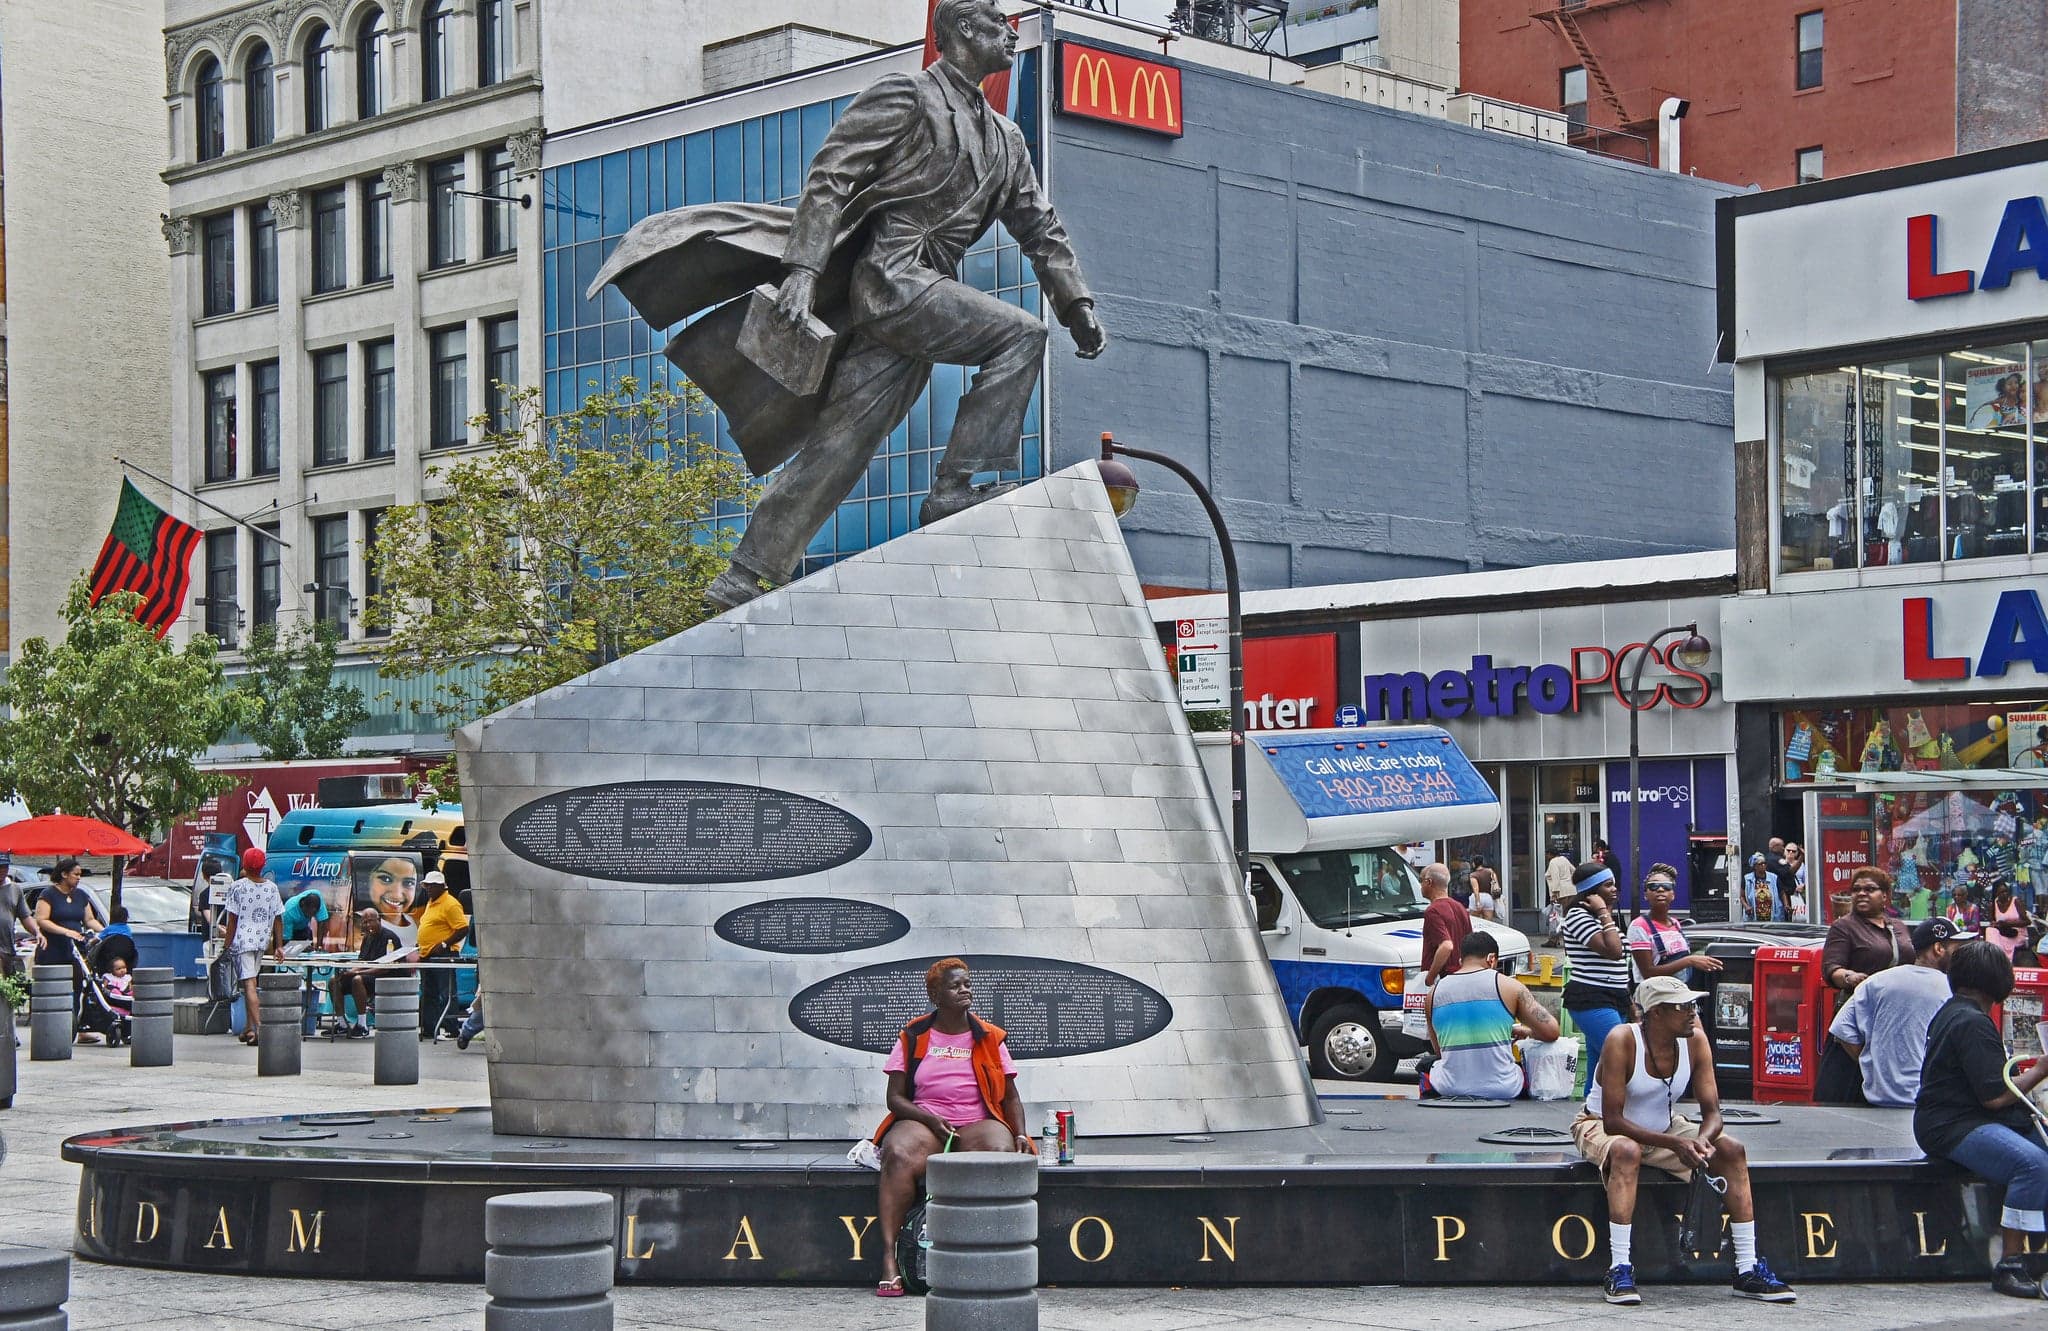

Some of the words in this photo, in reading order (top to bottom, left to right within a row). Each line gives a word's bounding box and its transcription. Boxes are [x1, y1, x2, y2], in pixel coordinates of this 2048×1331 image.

[1184, 655, 1191, 671] 1
[1365, 641, 1711, 721] metroPCS
[2009, 713, 2047, 722] SUMMER
[1305, 758, 1334, 776] Call
[1334, 754, 1399, 774] WellCare
[1399, 751, 1446, 771] today.
[1318, 770, 1457, 799] 1-800-288-5441
[556, 799, 792, 850] KEEP
[1825, 850, 1836, 863] Ice
[1836, 850, 1850, 863] Cold
[1851, 850, 1867, 863] Bliss
[1774, 949, 1799, 960] FREE
[2014, 972, 2039, 982] REE
